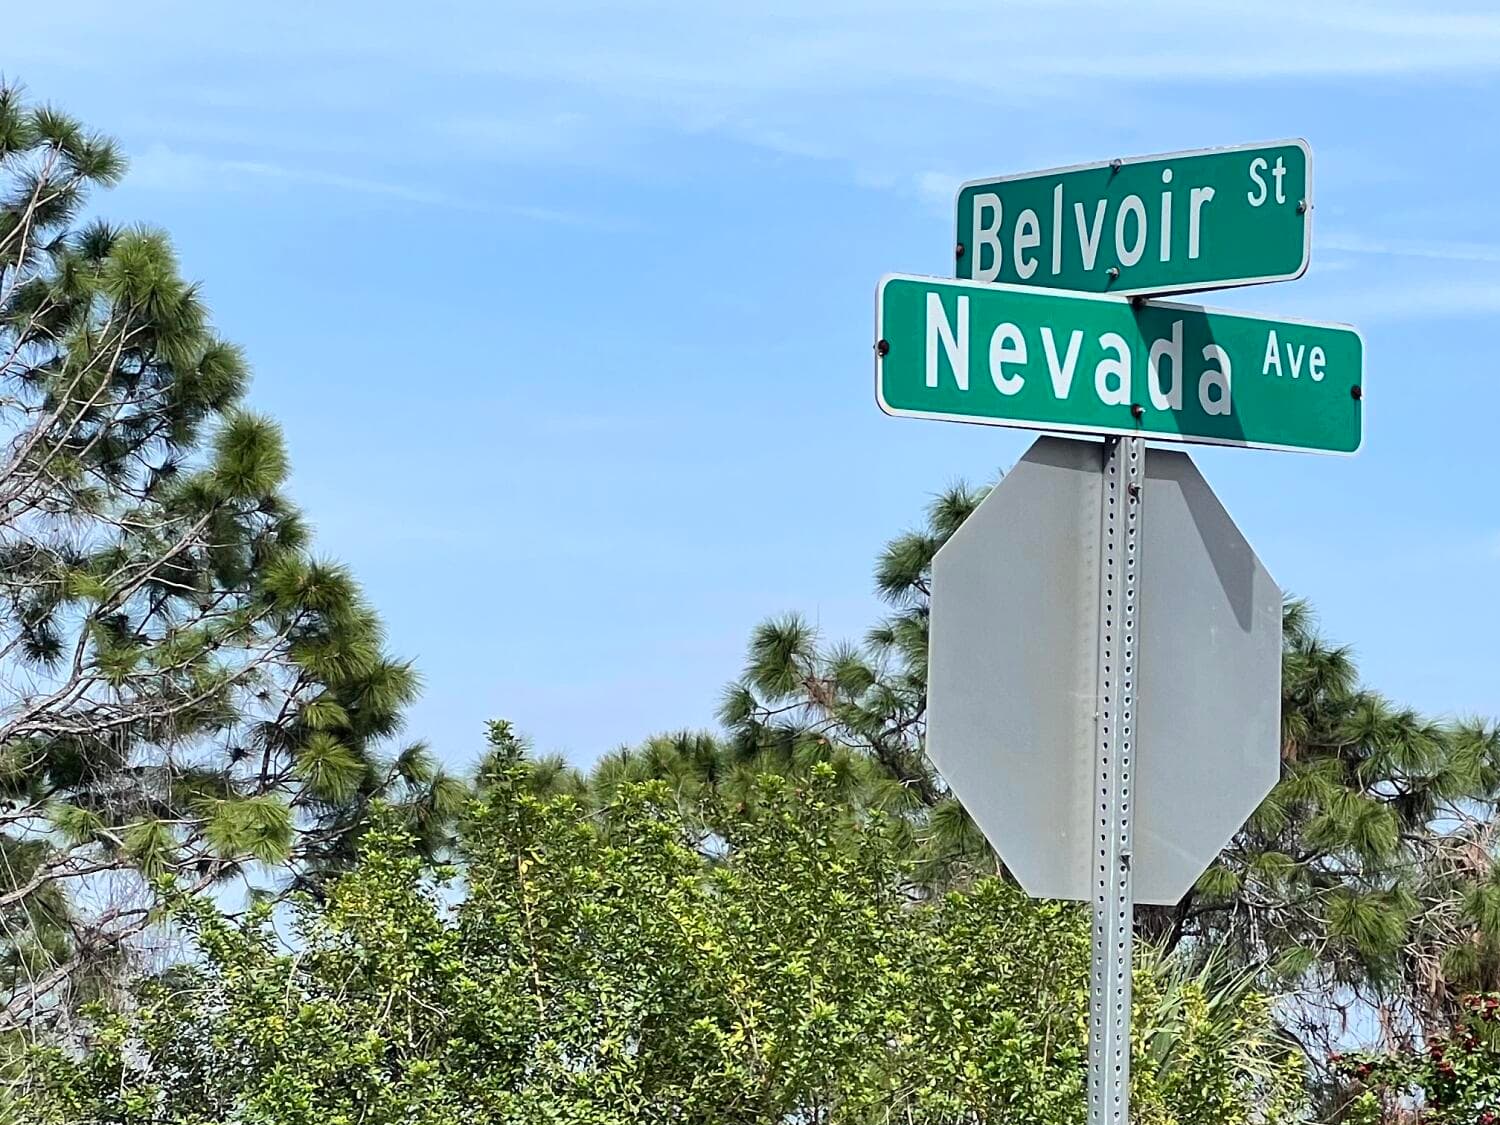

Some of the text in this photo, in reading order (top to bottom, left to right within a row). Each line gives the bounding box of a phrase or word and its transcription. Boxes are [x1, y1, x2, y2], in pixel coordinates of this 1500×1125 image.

[971, 156, 1287, 282] Belvoir St
[925, 292, 1327, 416] Nevada Ave
